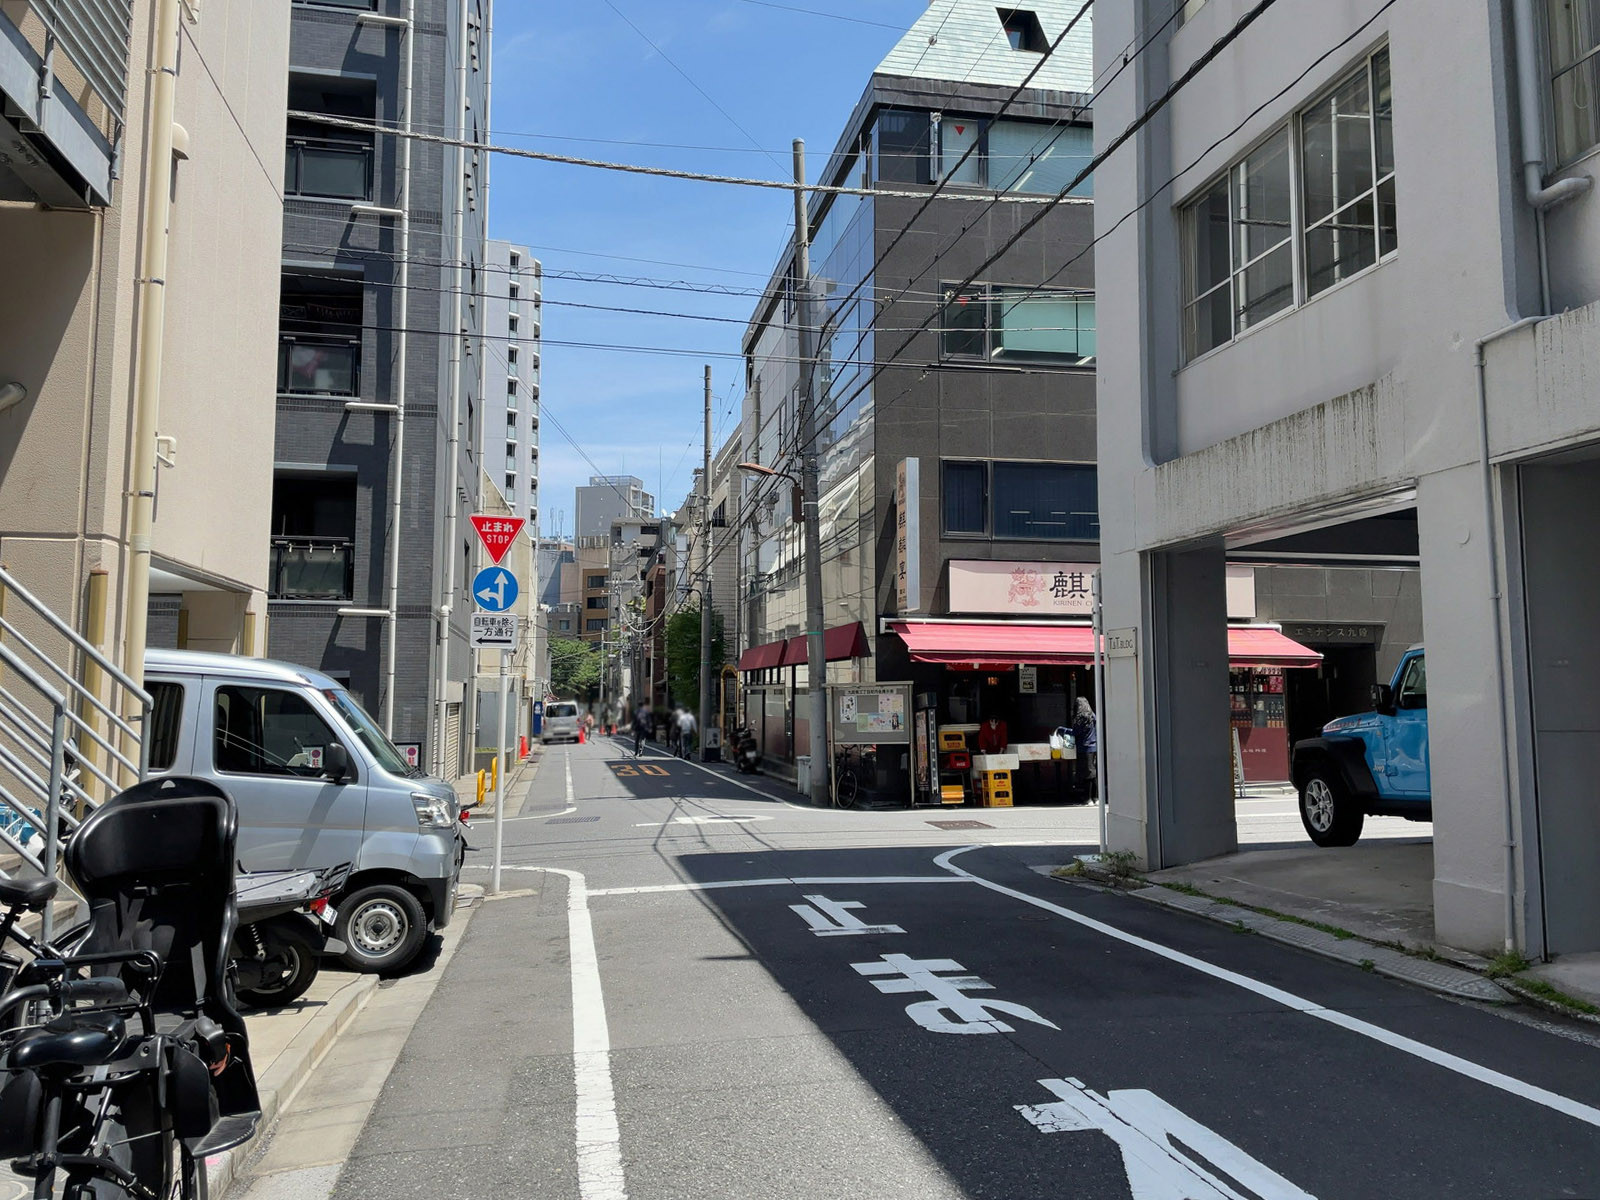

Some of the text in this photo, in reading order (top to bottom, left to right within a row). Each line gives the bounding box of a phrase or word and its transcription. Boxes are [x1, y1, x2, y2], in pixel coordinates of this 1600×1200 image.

[481, 521, 514, 533] 止まれ
[486, 534, 510, 544] STOP
[473, 617, 514, 627] 自転車を除く
[473, 627, 514, 637] 一方通行
[610, 764, 671, 776] 30
